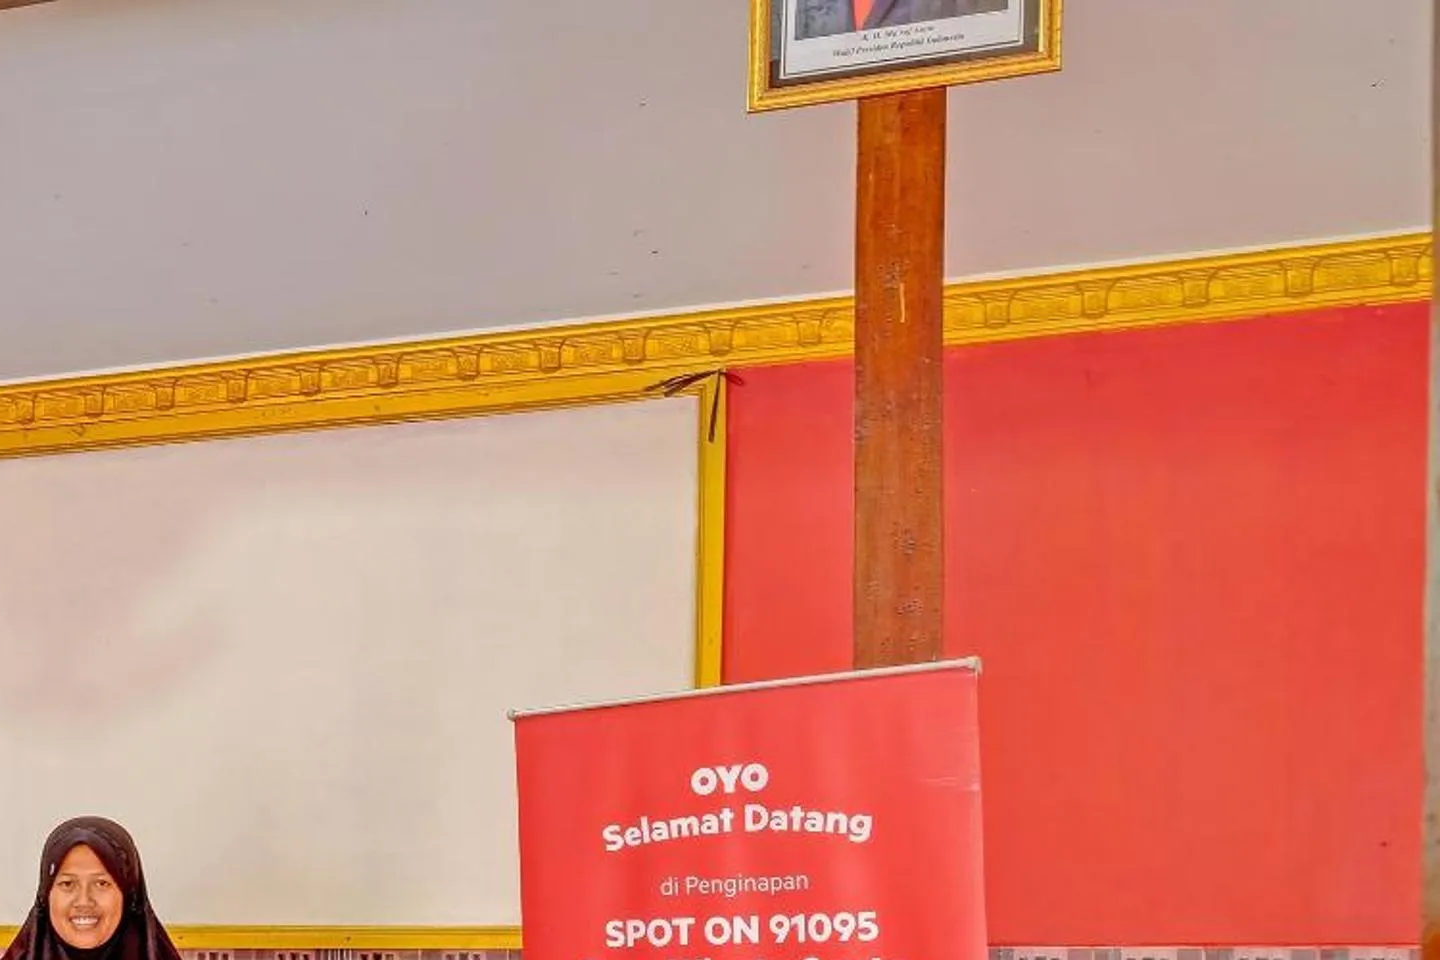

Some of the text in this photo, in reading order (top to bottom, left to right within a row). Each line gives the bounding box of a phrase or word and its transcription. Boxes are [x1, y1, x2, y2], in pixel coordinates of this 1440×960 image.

[691, 763, 769, 795] OYO
[602, 804, 873, 852] Selamat Datang
[660, 873, 809, 898] di Penginapan
[605, 911, 879, 948] SPOT ON 91095
